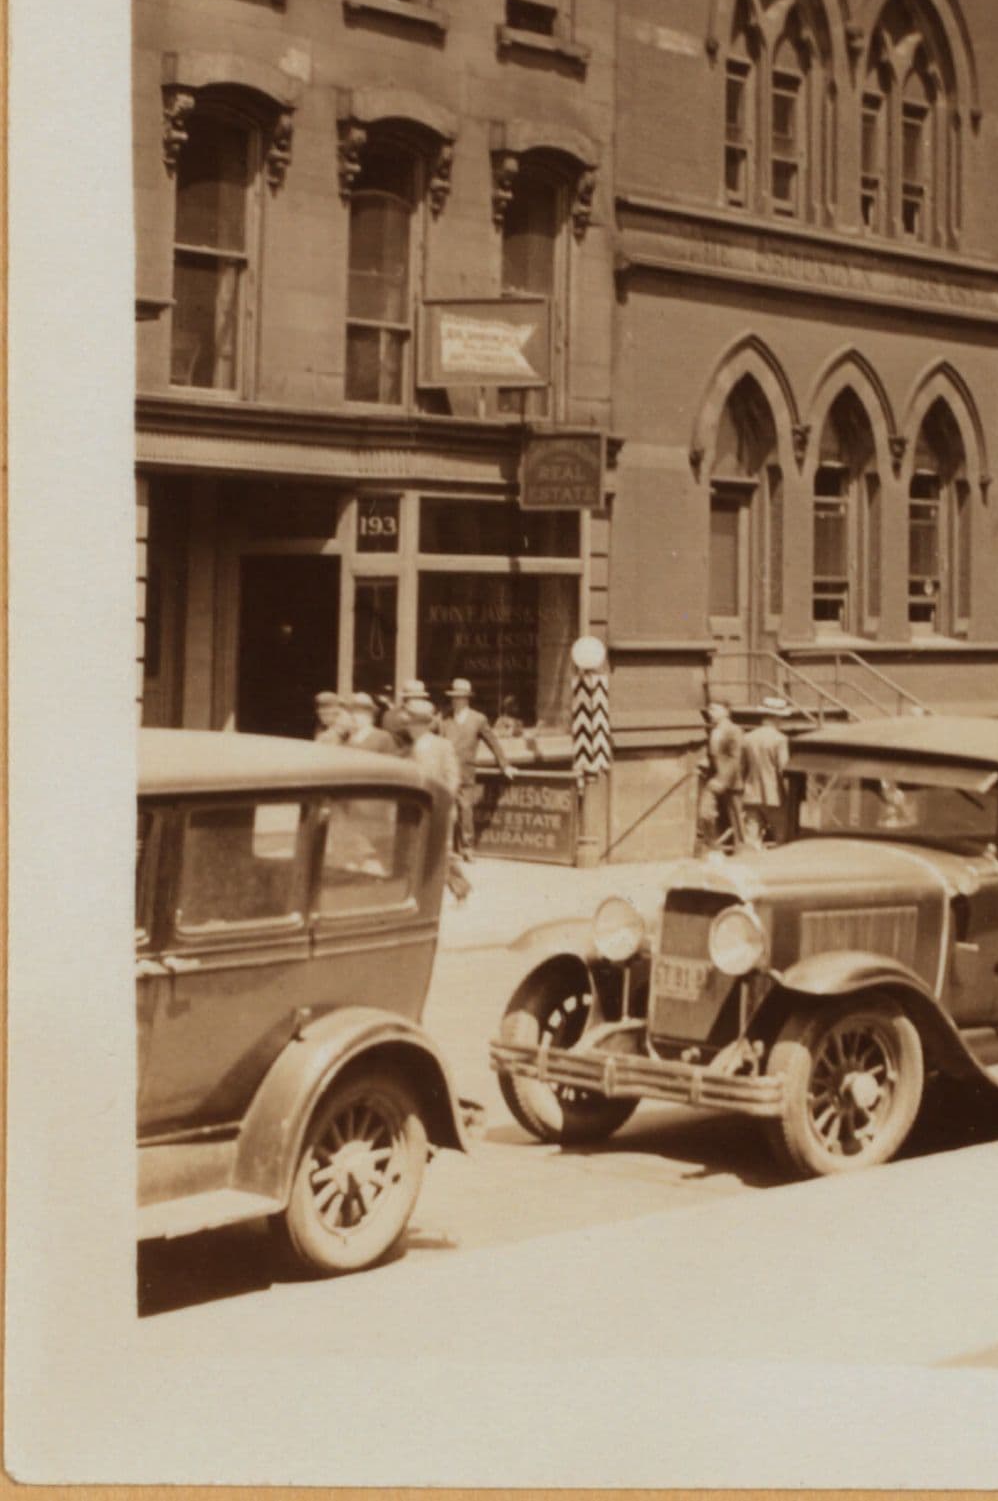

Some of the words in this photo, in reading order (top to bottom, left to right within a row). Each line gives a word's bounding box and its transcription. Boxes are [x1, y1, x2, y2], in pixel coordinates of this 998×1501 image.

[537, 465, 586, 482] REAL
[532, 485, 596, 502] ESTATE
[360, 515, 397, 536] 193
[504, 811, 562, 831] ESTATE
[480, 828, 556, 850] SURANCE
